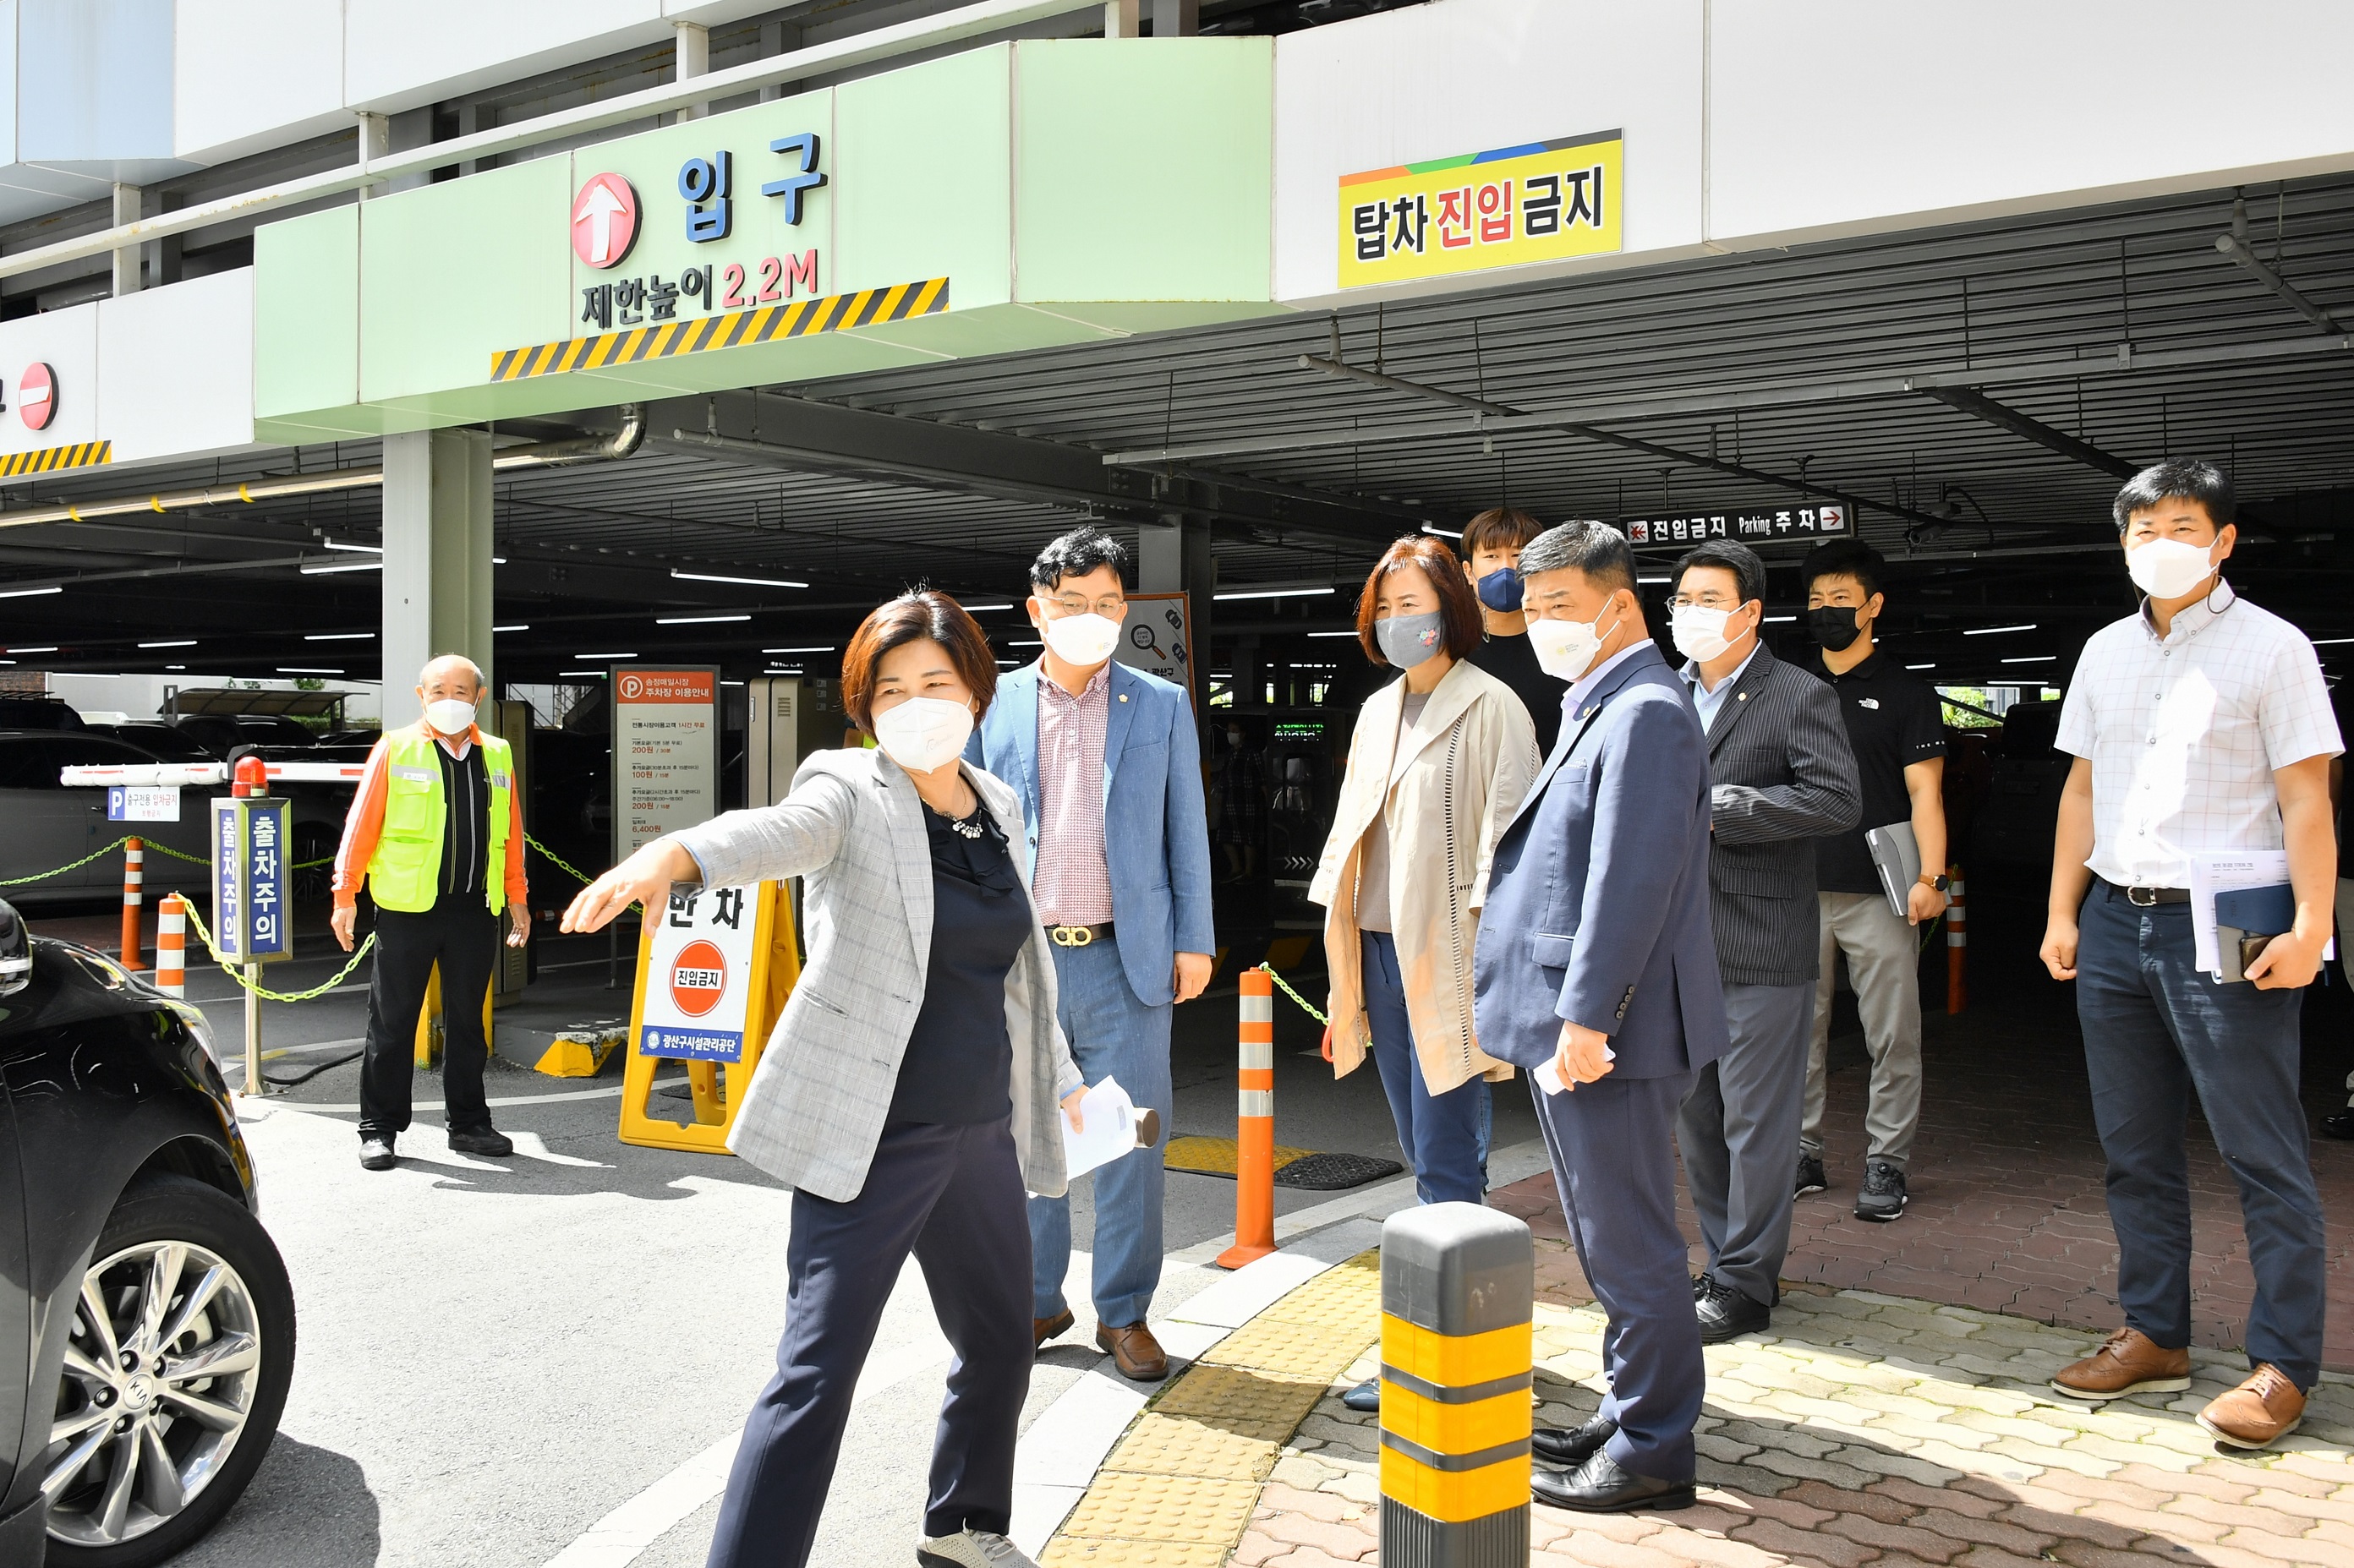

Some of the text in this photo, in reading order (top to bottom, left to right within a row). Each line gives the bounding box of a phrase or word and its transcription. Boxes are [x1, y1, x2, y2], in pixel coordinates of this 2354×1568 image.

[1354, 166, 1602, 260] 탑차 진입 금지
[582, 249, 818, 330] 제한높이 2.2M
[1652, 516, 1727, 541] 진입금지
[1738, 515, 1771, 536] Parking
[645, 678, 689, 686] 송정매일시장
[645, 688, 709, 697] 주차장 이용안내
[112, 790, 123, 817] P
[128, 794, 178, 806] 출구전용 입차금지
[632, 825, 661, 833] 6,400원
[253, 816, 277, 944] 출차주의
[677, 970, 719, 987] 진입금지
[662, 1034, 736, 1053] 광산구시설관리공단
[130, 1380, 148, 1404] KIA
